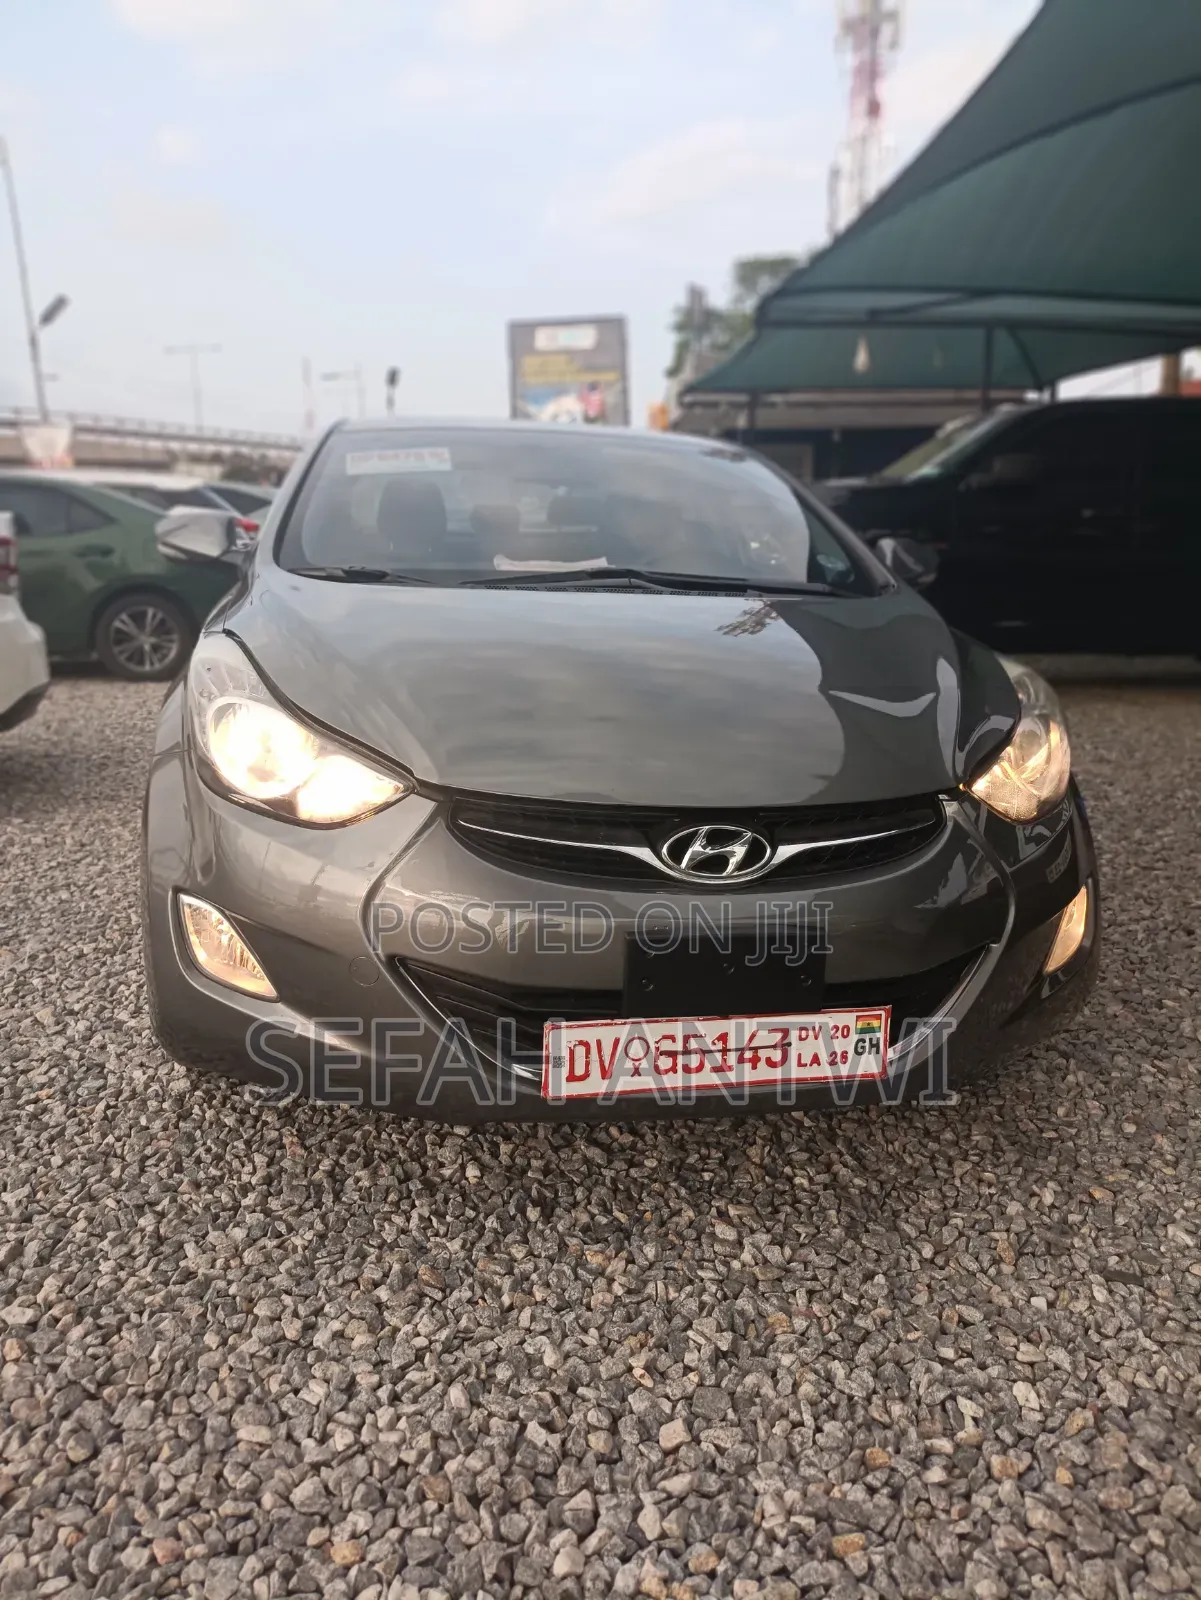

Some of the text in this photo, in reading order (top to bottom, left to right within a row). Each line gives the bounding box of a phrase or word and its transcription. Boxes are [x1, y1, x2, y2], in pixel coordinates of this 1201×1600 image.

[797, 1024, 851, 1042] DV 20
[853, 1037, 881, 1056] GH
[566, 1037, 621, 1083] DV
[796, 1050, 849, 1068] LA 26
